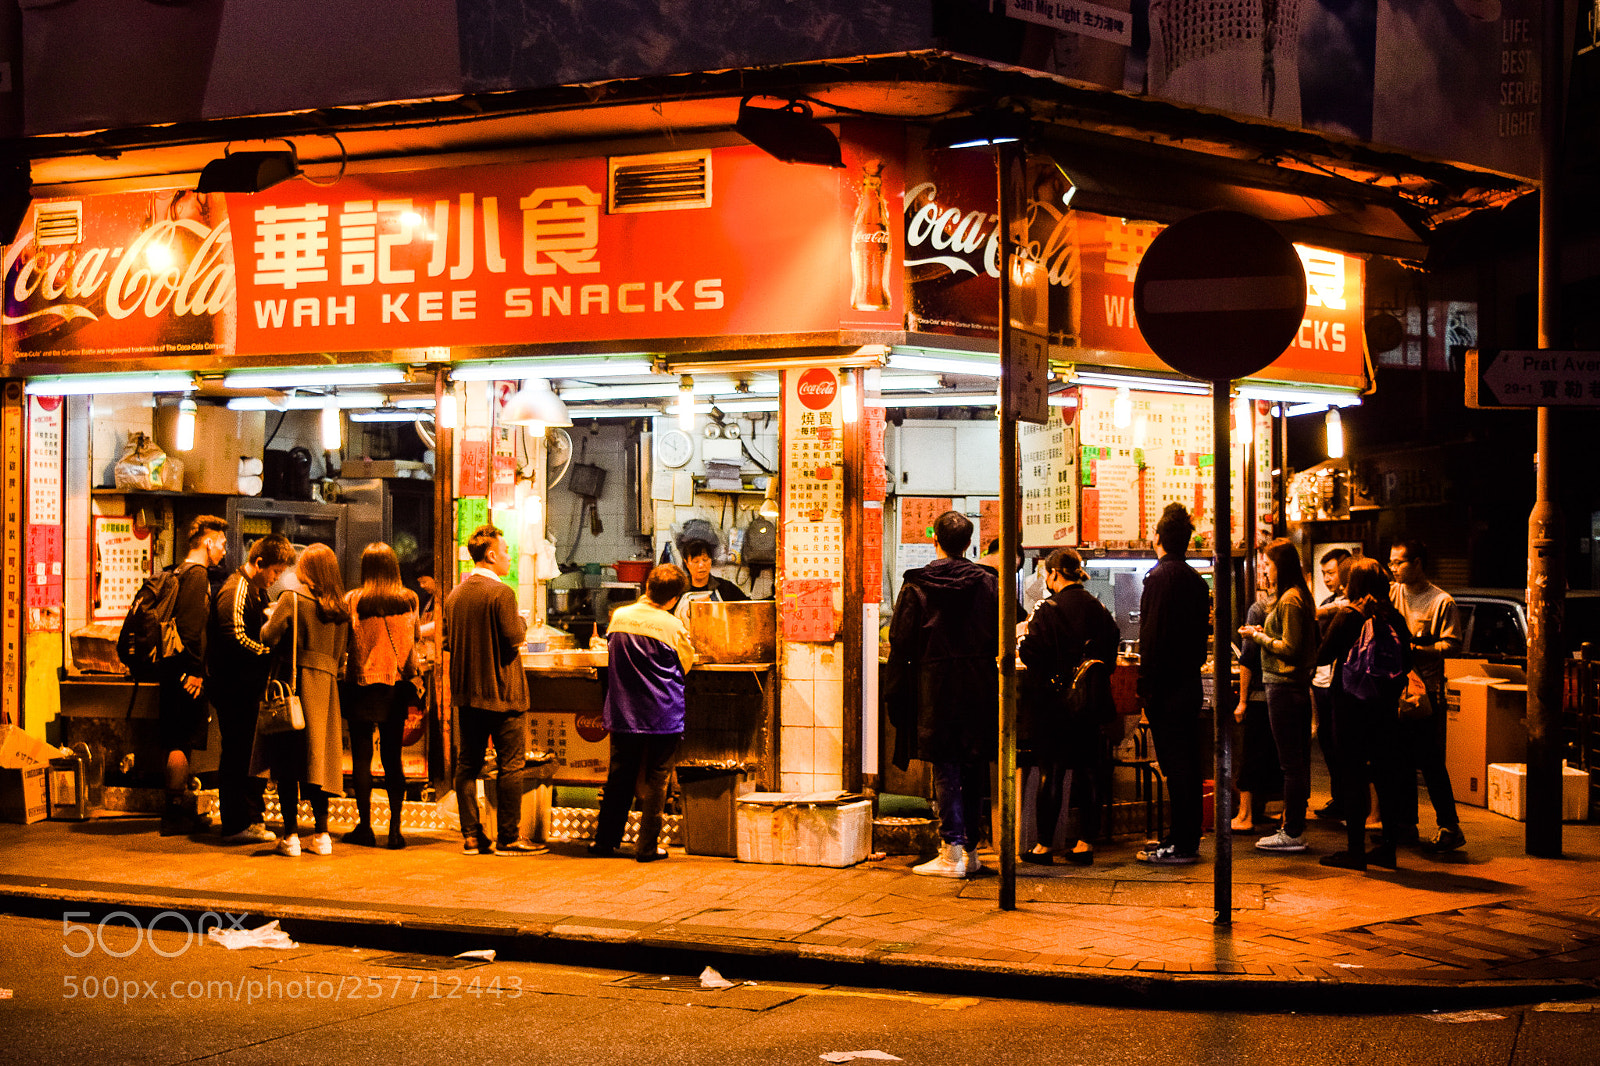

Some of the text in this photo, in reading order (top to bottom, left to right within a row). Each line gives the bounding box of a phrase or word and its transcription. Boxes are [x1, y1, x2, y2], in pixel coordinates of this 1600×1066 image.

[1056, 4, 1081, 24] Light
[254, 185, 601, 290] 華記小食
[254, 279, 725, 329] WAH KEE SNACKS
[1290, 319, 1346, 353] CKS
[1523, 356, 1557, 371] Prat
[799, 381, 835, 396] Coca-Cola
[1504, 383, 1533, 395] 29-1
